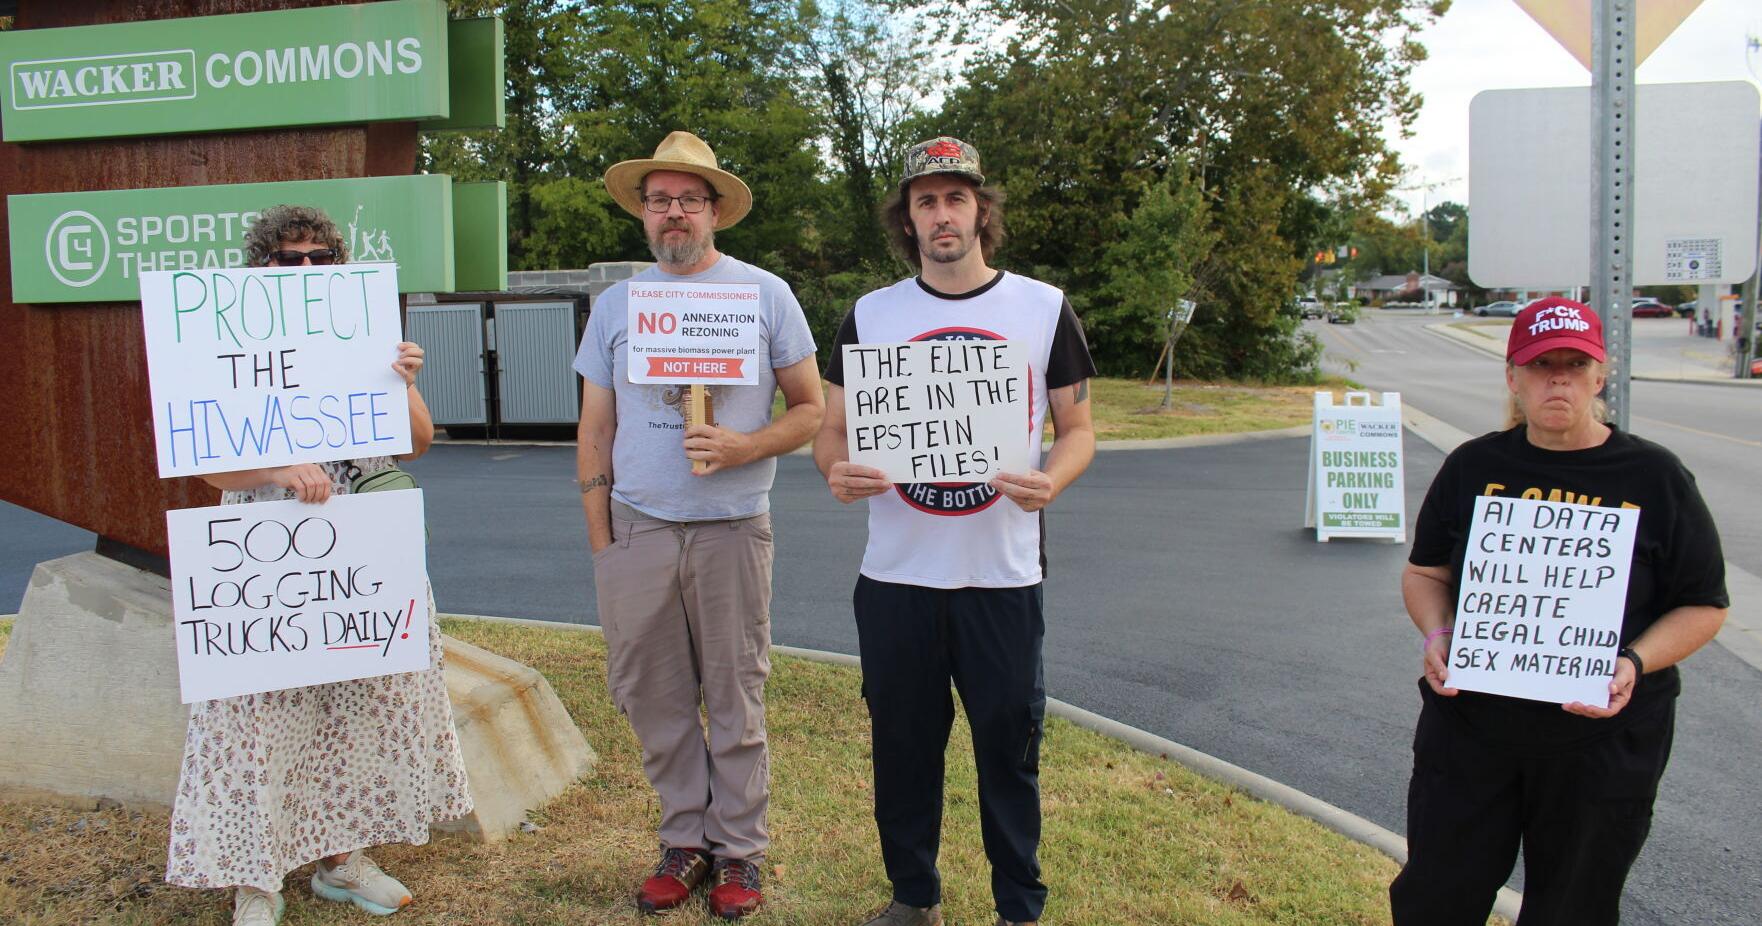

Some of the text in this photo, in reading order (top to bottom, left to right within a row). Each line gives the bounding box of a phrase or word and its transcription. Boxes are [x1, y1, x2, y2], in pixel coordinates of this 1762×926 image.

[18, 37, 423, 100] WACKER COMMONS
[116, 248, 244, 279] THERAP
[172, 270, 380, 348] PROTECT
[631, 290, 663, 298] PLEASE
[687, 292, 758, 300] COMMISSIONERS
[638, 312, 677, 334] NO
[682, 313, 755, 324] ANNEXATION
[682, 327, 739, 337] REZONING
[1529, 318, 1590, 336] TRUMP
[633, 345, 643, 353] for
[678, 346, 709, 354] biomass
[736, 347, 755, 355] plant
[850, 344, 1009, 379] THE ELITE
[217, 349, 299, 389] THE
[663, 362, 727, 373] NOT HERE
[856, 377, 1018, 416] ARE IN THE
[168, 392, 394, 467] HIWASSEE
[856, 415, 972, 451] EPSTEIN
[1336, 419, 1356, 430] PIE
[911, 446, 1000, 478] FILES!
[1322, 451, 1398, 468] BUSINESS
[1327, 472, 1394, 488] PARKING
[907, 482, 996, 508] THE BOTTO
[1342, 492, 1379, 509] ONLY
[1483, 501, 1620, 533] AI DATA
[208, 516, 336, 572] 500
[1480, 532, 1611, 558] CENTERS
[190, 565, 382, 611] LOGGING
[1469, 560, 1615, 589] WILL HELP
[1463, 592, 1570, 618] CREATE
[181, 599, 415, 657] TRUCKS DAILY!
[1460, 621, 1618, 648] LEGAL CHILD
[1455, 647, 1615, 678] SEX MATERIAL
